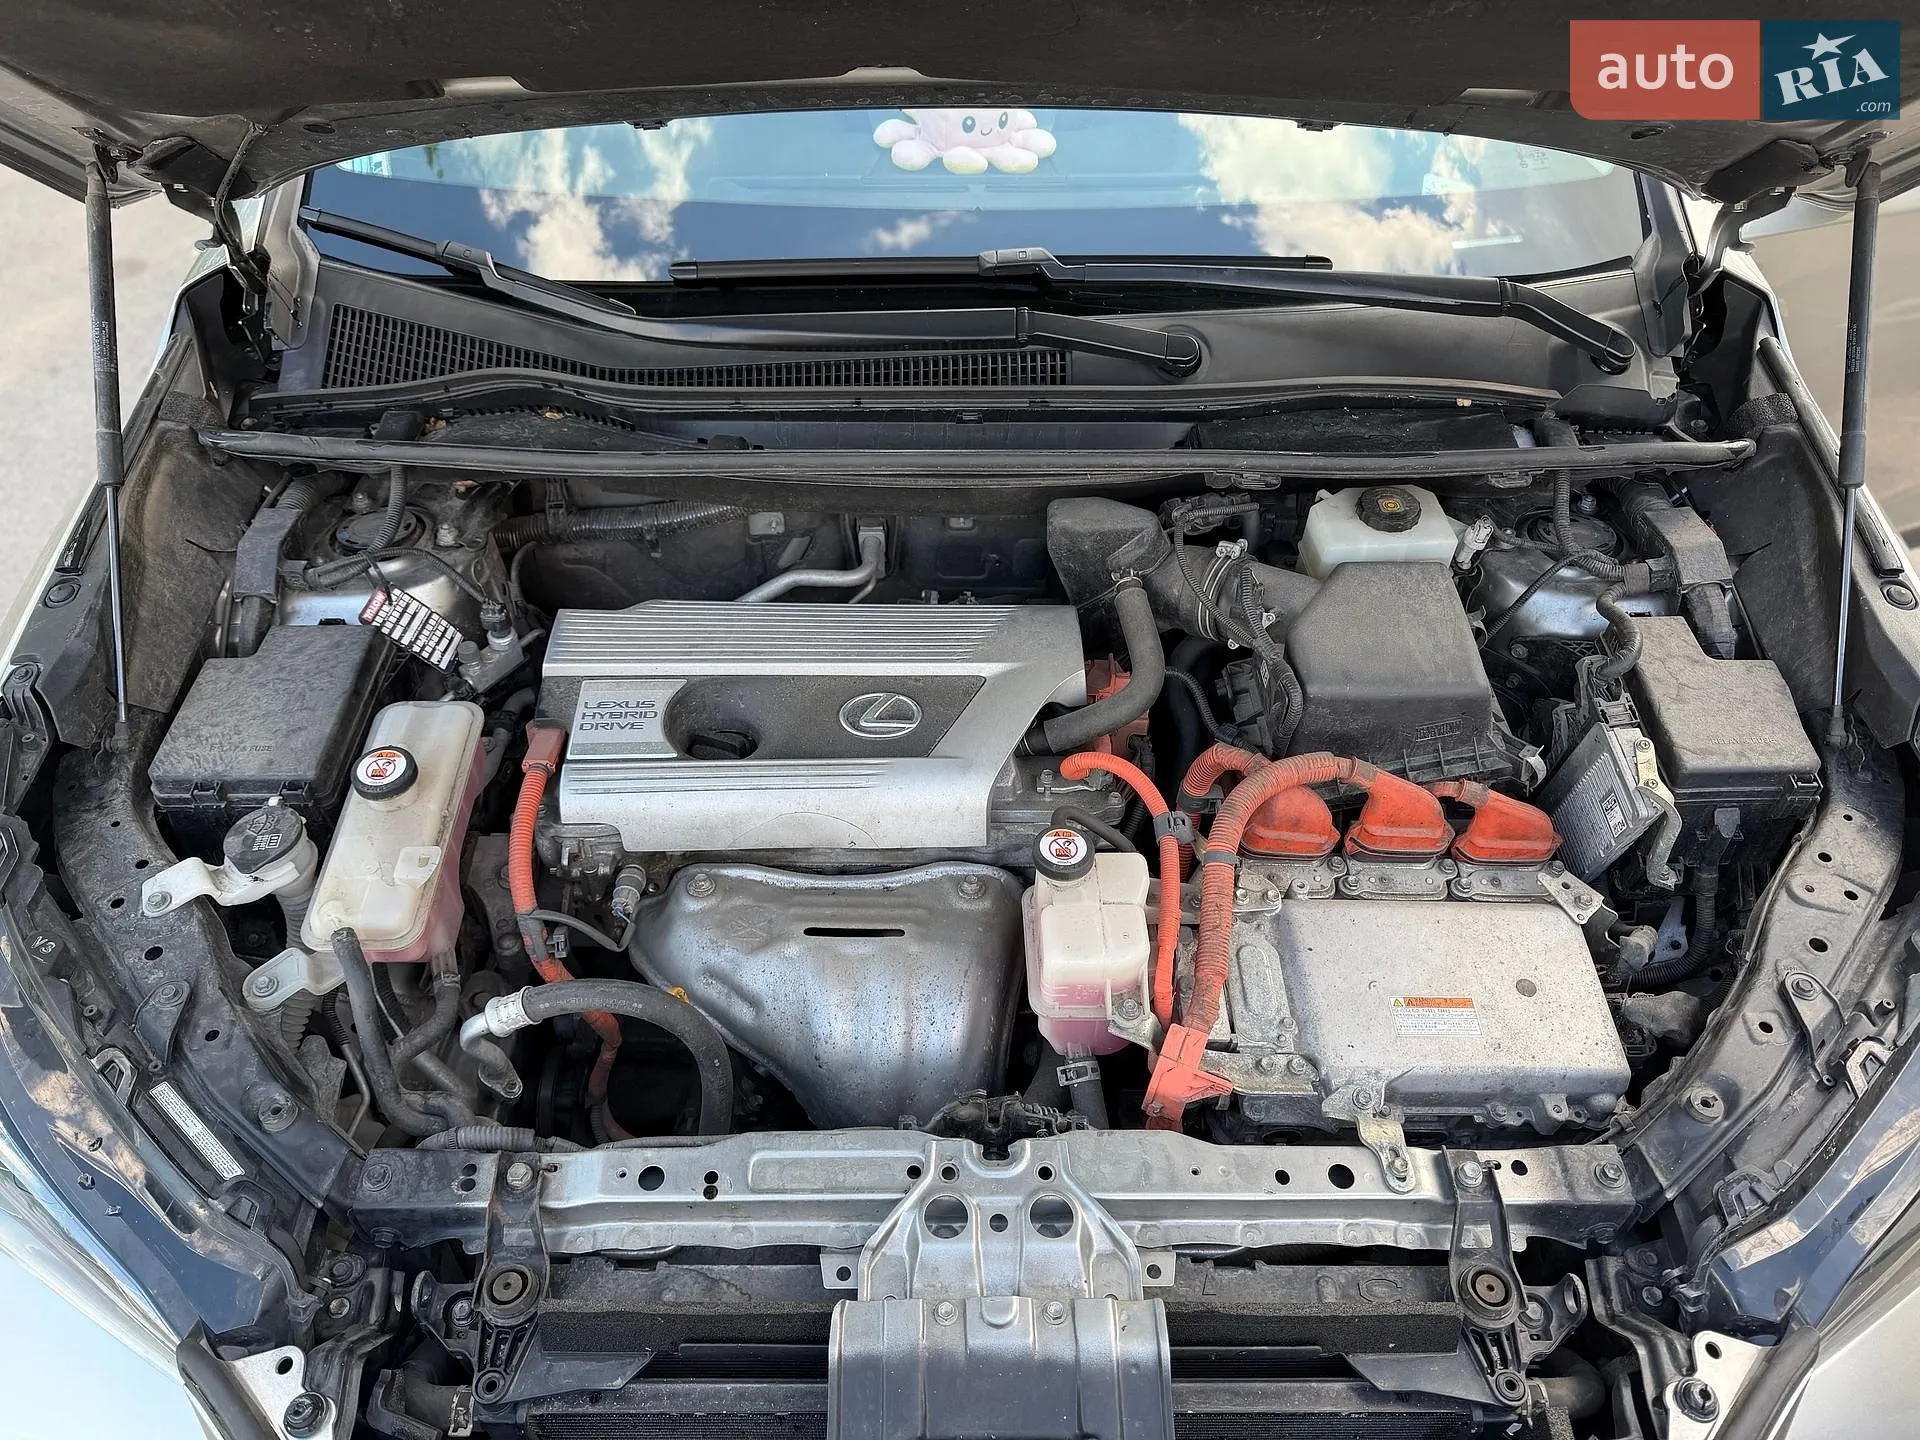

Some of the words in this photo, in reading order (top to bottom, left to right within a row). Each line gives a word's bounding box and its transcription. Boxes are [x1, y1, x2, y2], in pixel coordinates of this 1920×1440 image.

[583, 700, 656, 709] LEXUS
[581, 710, 658, 720] HYBRID
[579, 721, 645, 731] DRIVE
